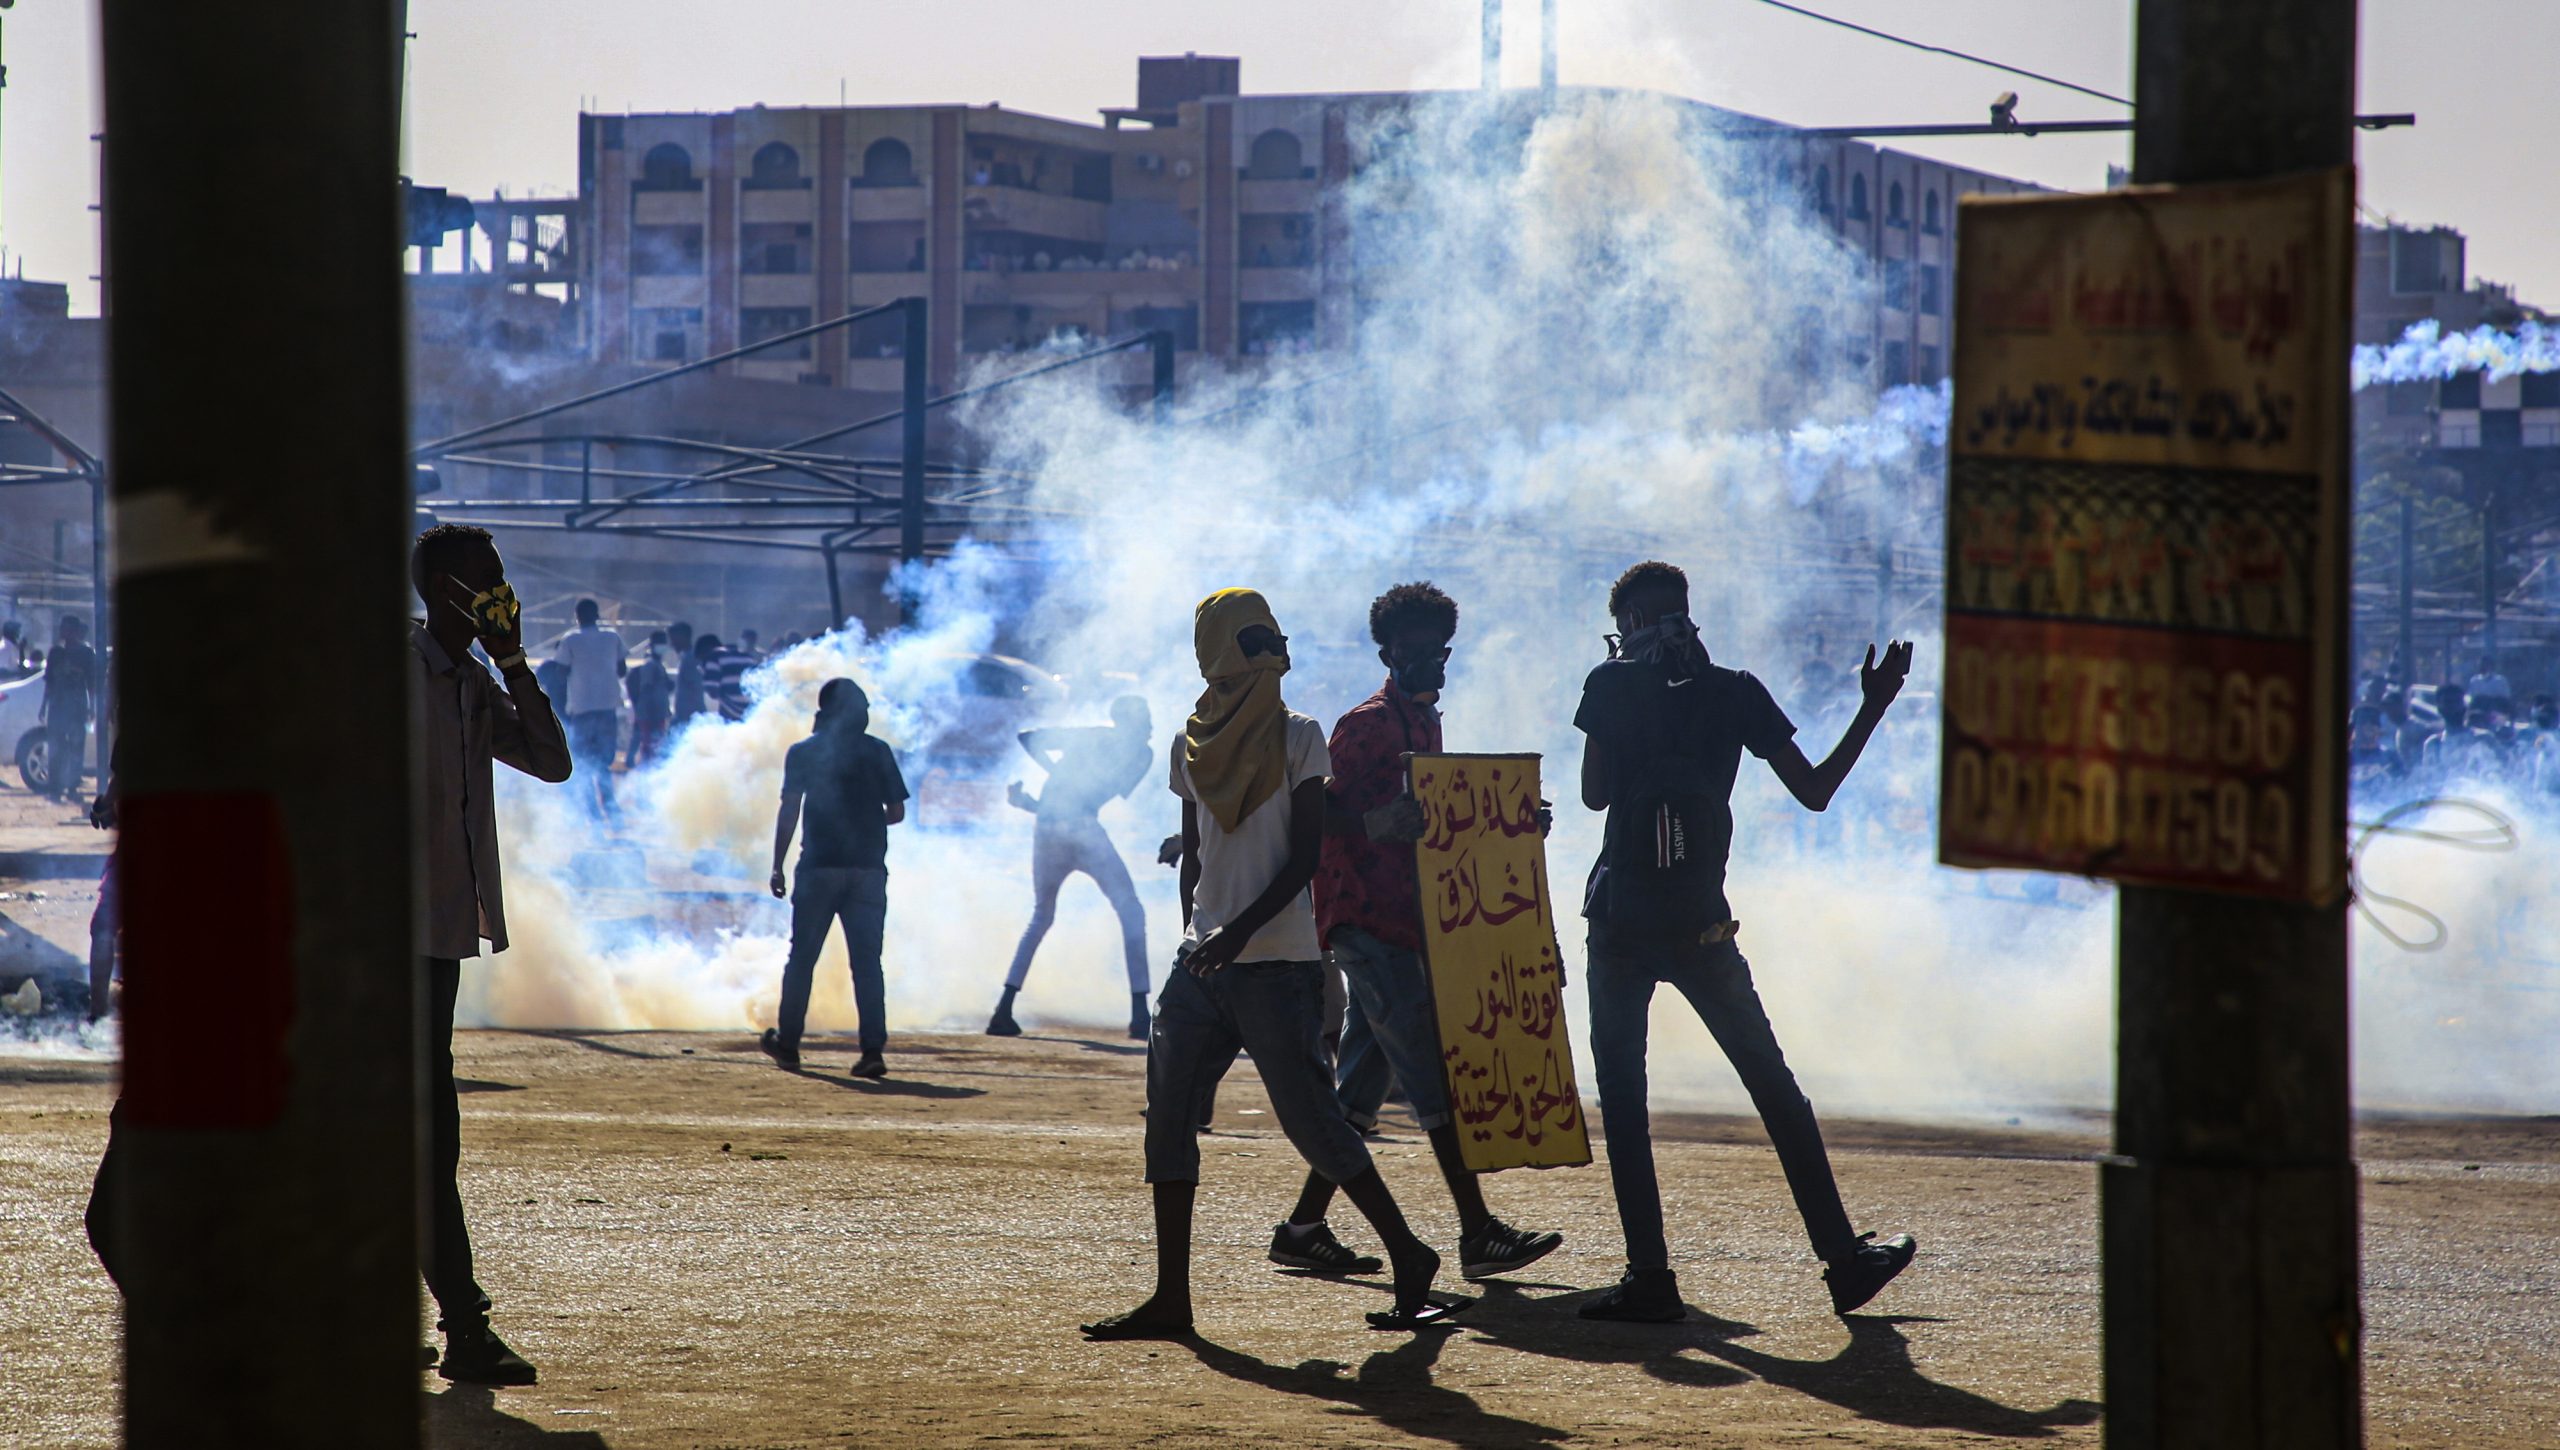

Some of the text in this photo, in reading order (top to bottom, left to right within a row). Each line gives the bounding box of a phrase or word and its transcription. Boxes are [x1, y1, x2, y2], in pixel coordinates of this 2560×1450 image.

[1673, 812, 1686, 861] ANTASTIC
[1461, 945, 1557, 1040] ثورة النور
[1445, 1044, 1577, 1147] والحق والحقيقة
